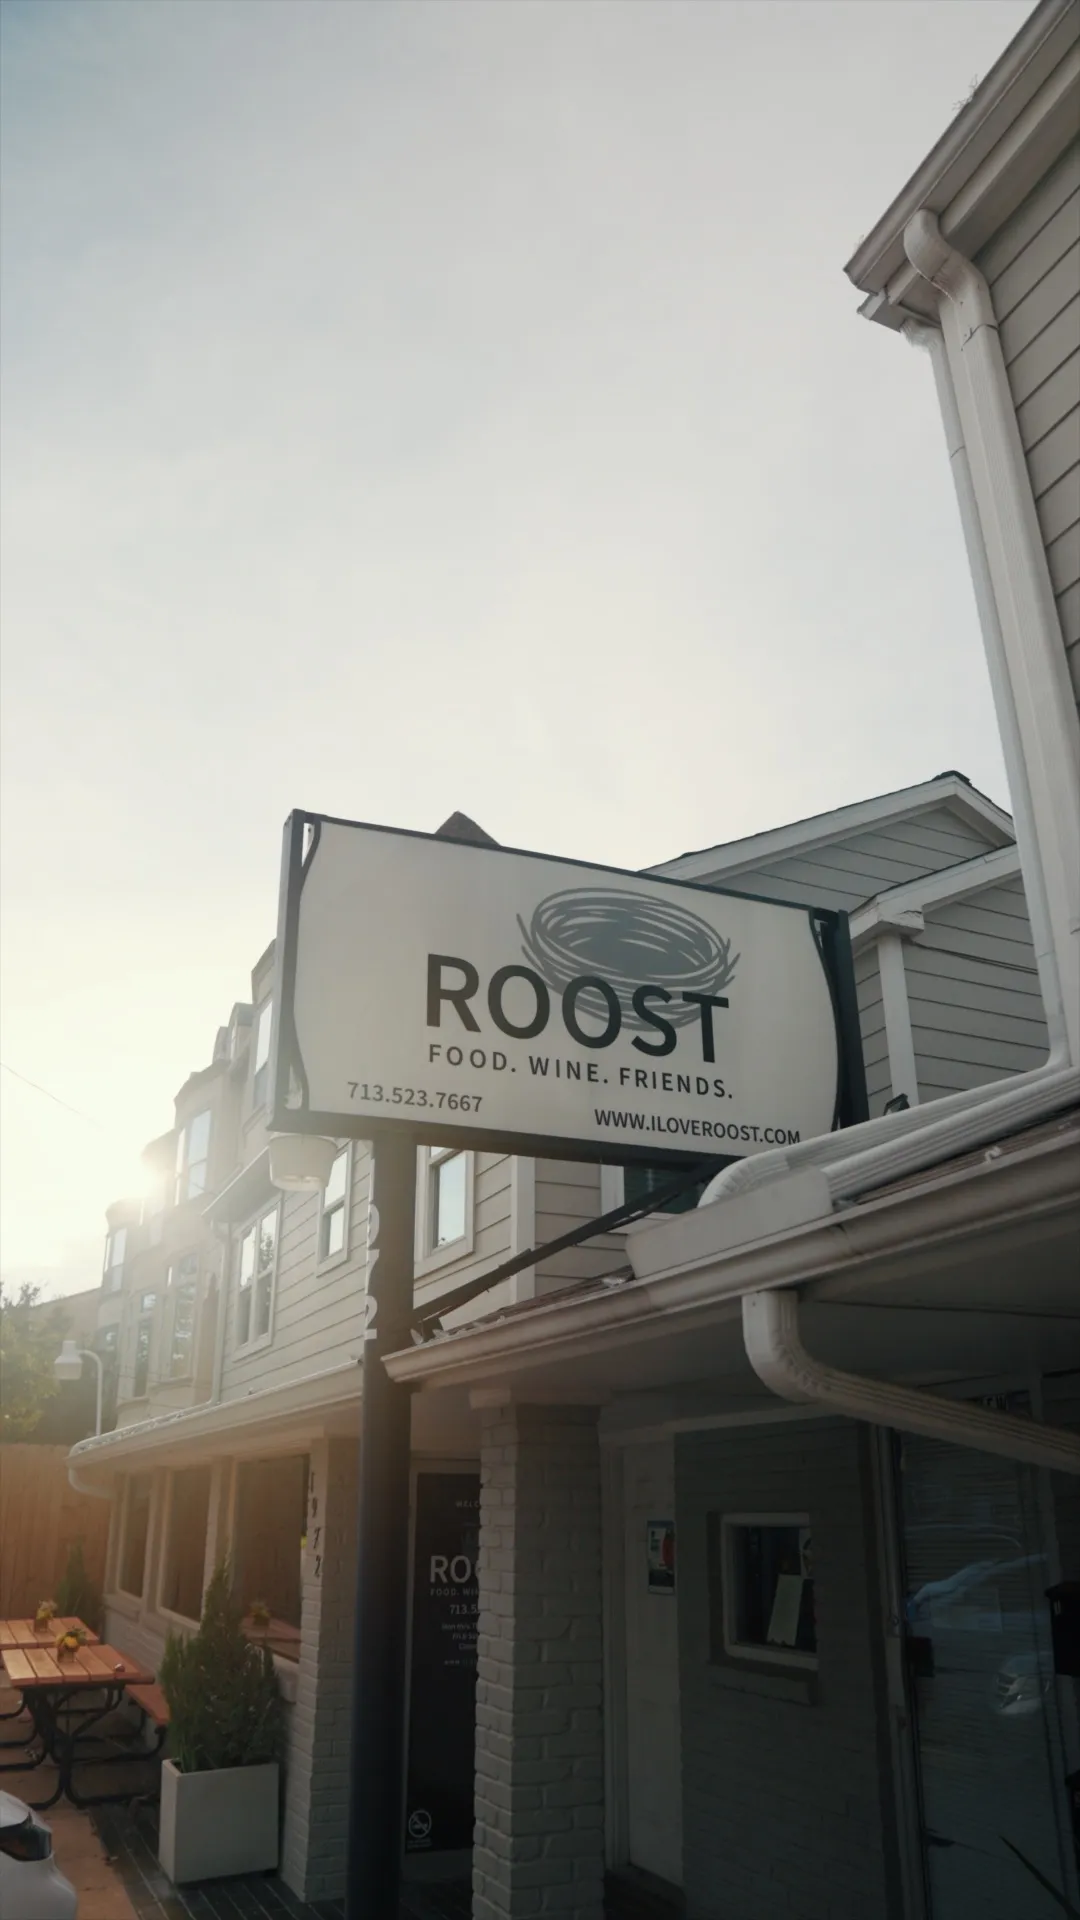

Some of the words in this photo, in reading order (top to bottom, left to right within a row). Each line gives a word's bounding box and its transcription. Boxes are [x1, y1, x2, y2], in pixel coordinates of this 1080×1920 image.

[427, 953, 729, 1063] ROOST
[429, 1044, 516, 1073] FOOD.
[529, 1056, 608, 1084] WINE.
[619, 1067, 732, 1099] FRIENDS.
[347, 1081, 483, 1113] 713.523.7667
[594, 1109, 800, 1144] WWW.ILOVEROOST.COM
[449, 1604, 479, 1615] 713.5
